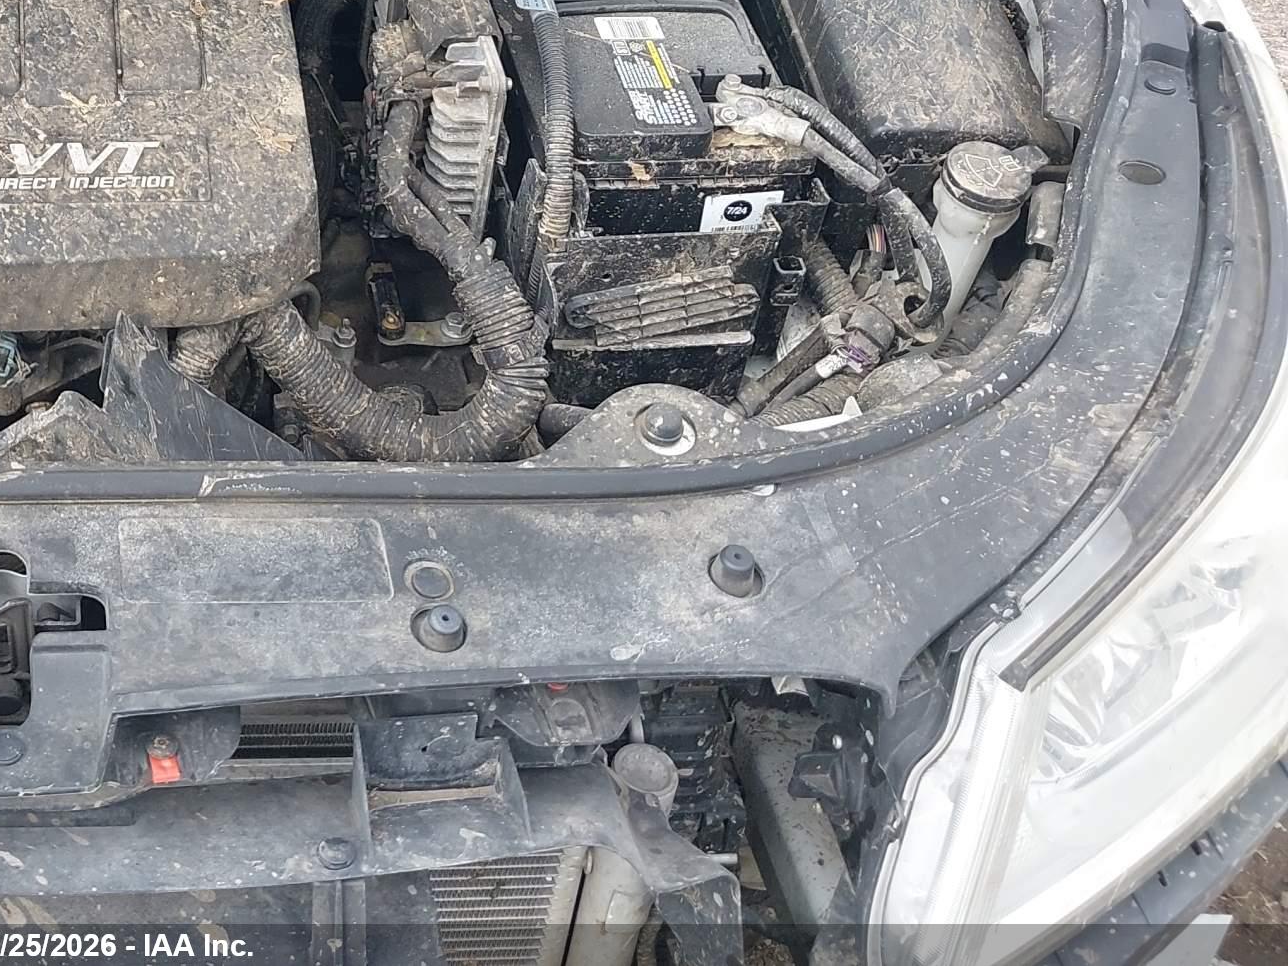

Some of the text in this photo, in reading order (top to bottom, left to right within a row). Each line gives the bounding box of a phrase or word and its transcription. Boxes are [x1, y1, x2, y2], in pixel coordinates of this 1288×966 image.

[9, 141, 161, 175] VVT
[69, 175, 175, 189] INJECTION
[726, 206, 749, 216] 7/24
